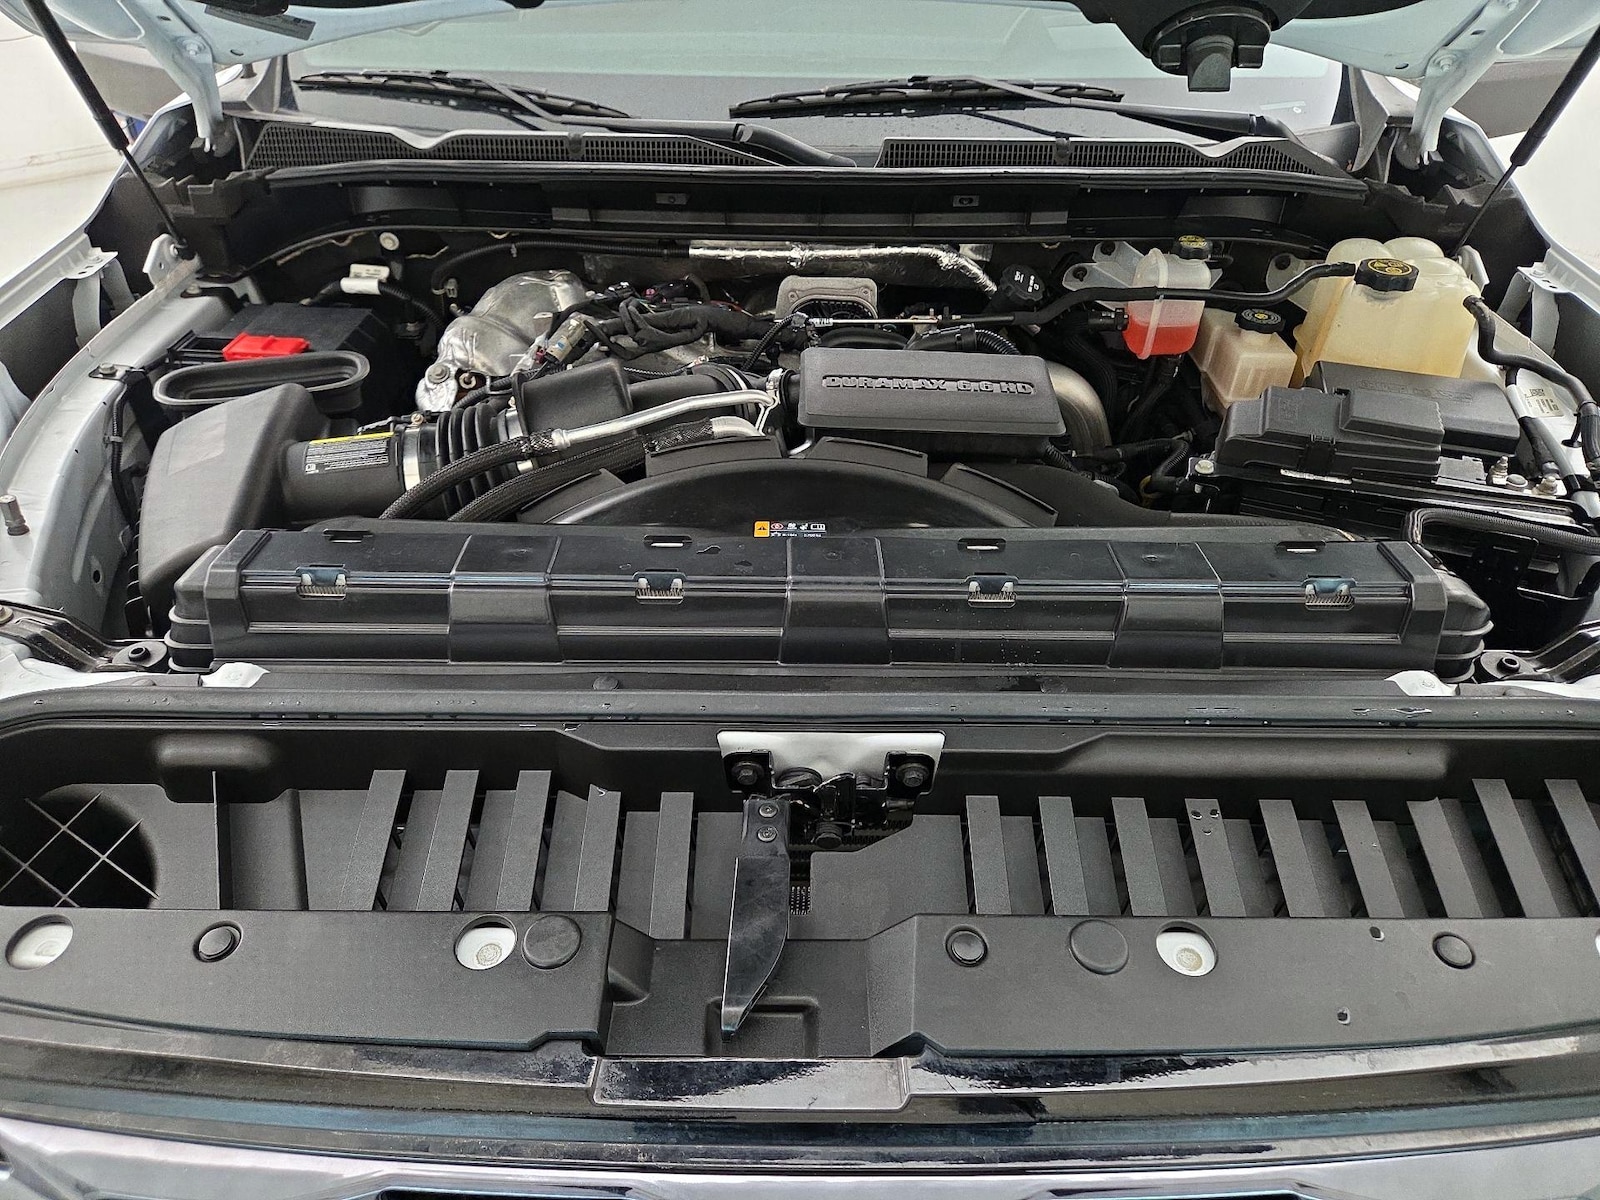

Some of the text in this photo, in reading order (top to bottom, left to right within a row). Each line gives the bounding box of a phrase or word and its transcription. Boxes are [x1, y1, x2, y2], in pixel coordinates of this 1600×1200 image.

[825, 376, 1033, 394] DURAMAX 6.6 HD
